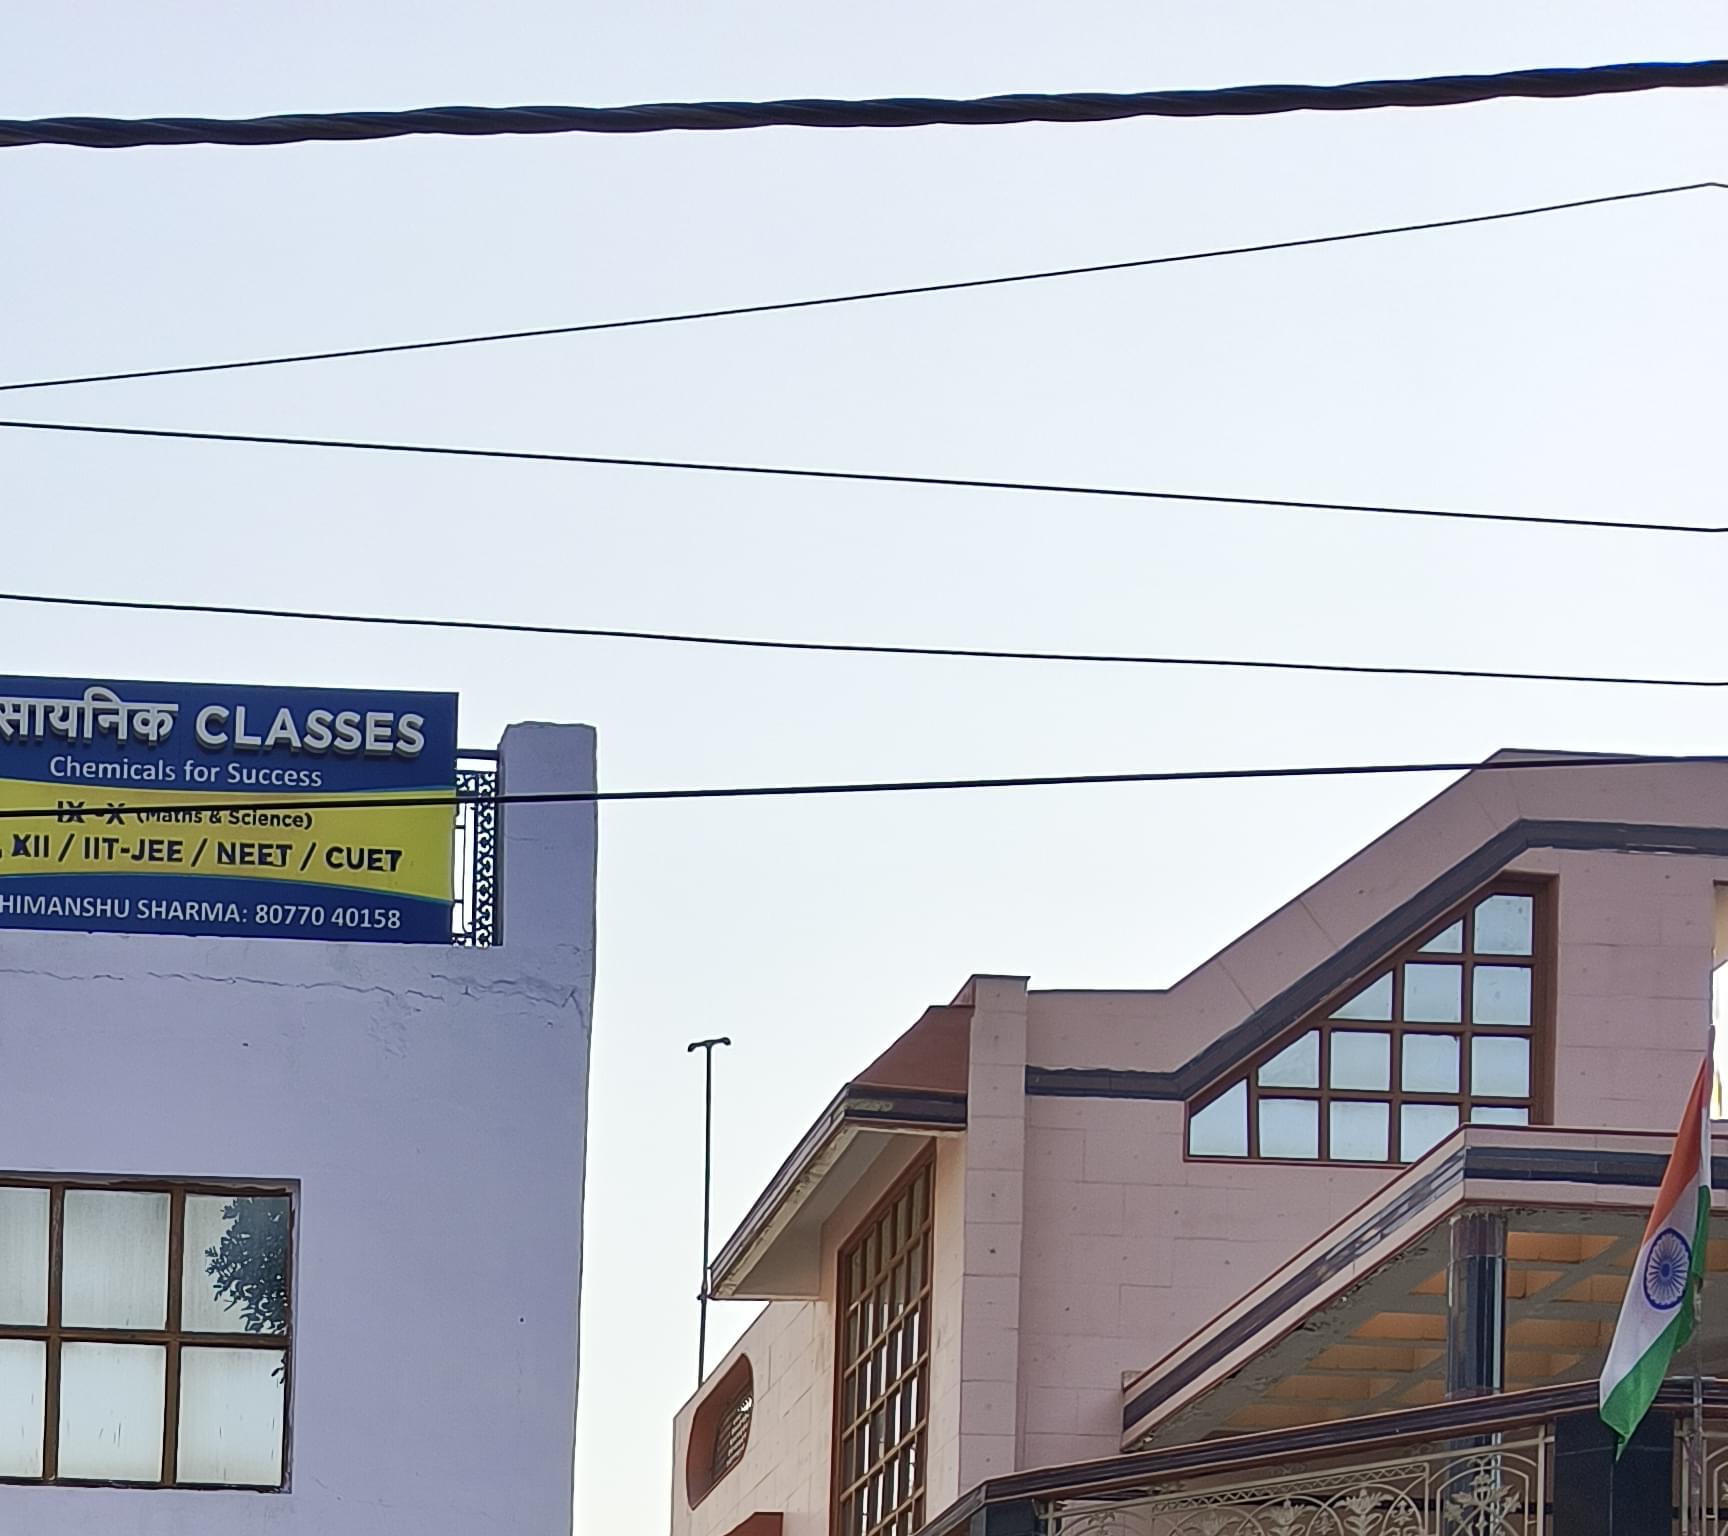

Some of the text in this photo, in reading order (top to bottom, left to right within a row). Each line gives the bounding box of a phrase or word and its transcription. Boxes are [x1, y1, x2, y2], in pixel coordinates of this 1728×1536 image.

[195, 705, 425, 755] CLASSES
[50, 755, 322, 787] Chemicals for Success
[228, 810, 313, 830] Science)
[11, 834, 50, 858] XII
[84, 837, 183, 862] IIT-JEE
[217, 841, 293, 867] NEET
[325, 846, 402, 872] CUET
[0, 894, 130, 918] HIMANSHU
[137, 899, 247, 922] SHARMA:
[255, 904, 324, 925] 80770
[331, 908, 401, 929] 40158
